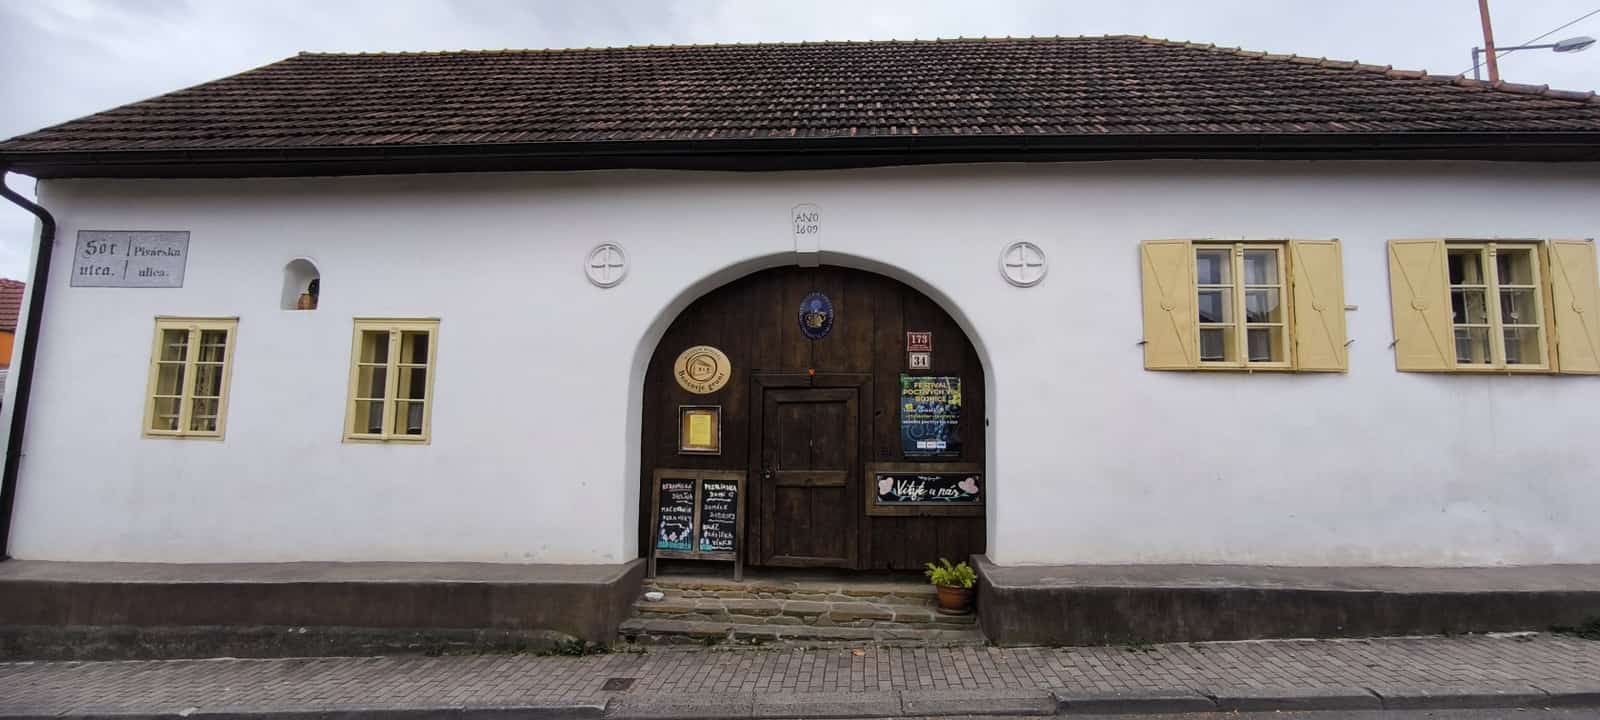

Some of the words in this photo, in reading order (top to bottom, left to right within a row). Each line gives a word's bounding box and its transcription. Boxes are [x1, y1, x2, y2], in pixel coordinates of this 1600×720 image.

[796, 223, 818, 234] 1609
[79, 264, 115, 276] utca.
[912, 334, 928, 344] 173
[937, 484, 960, 497] nás
